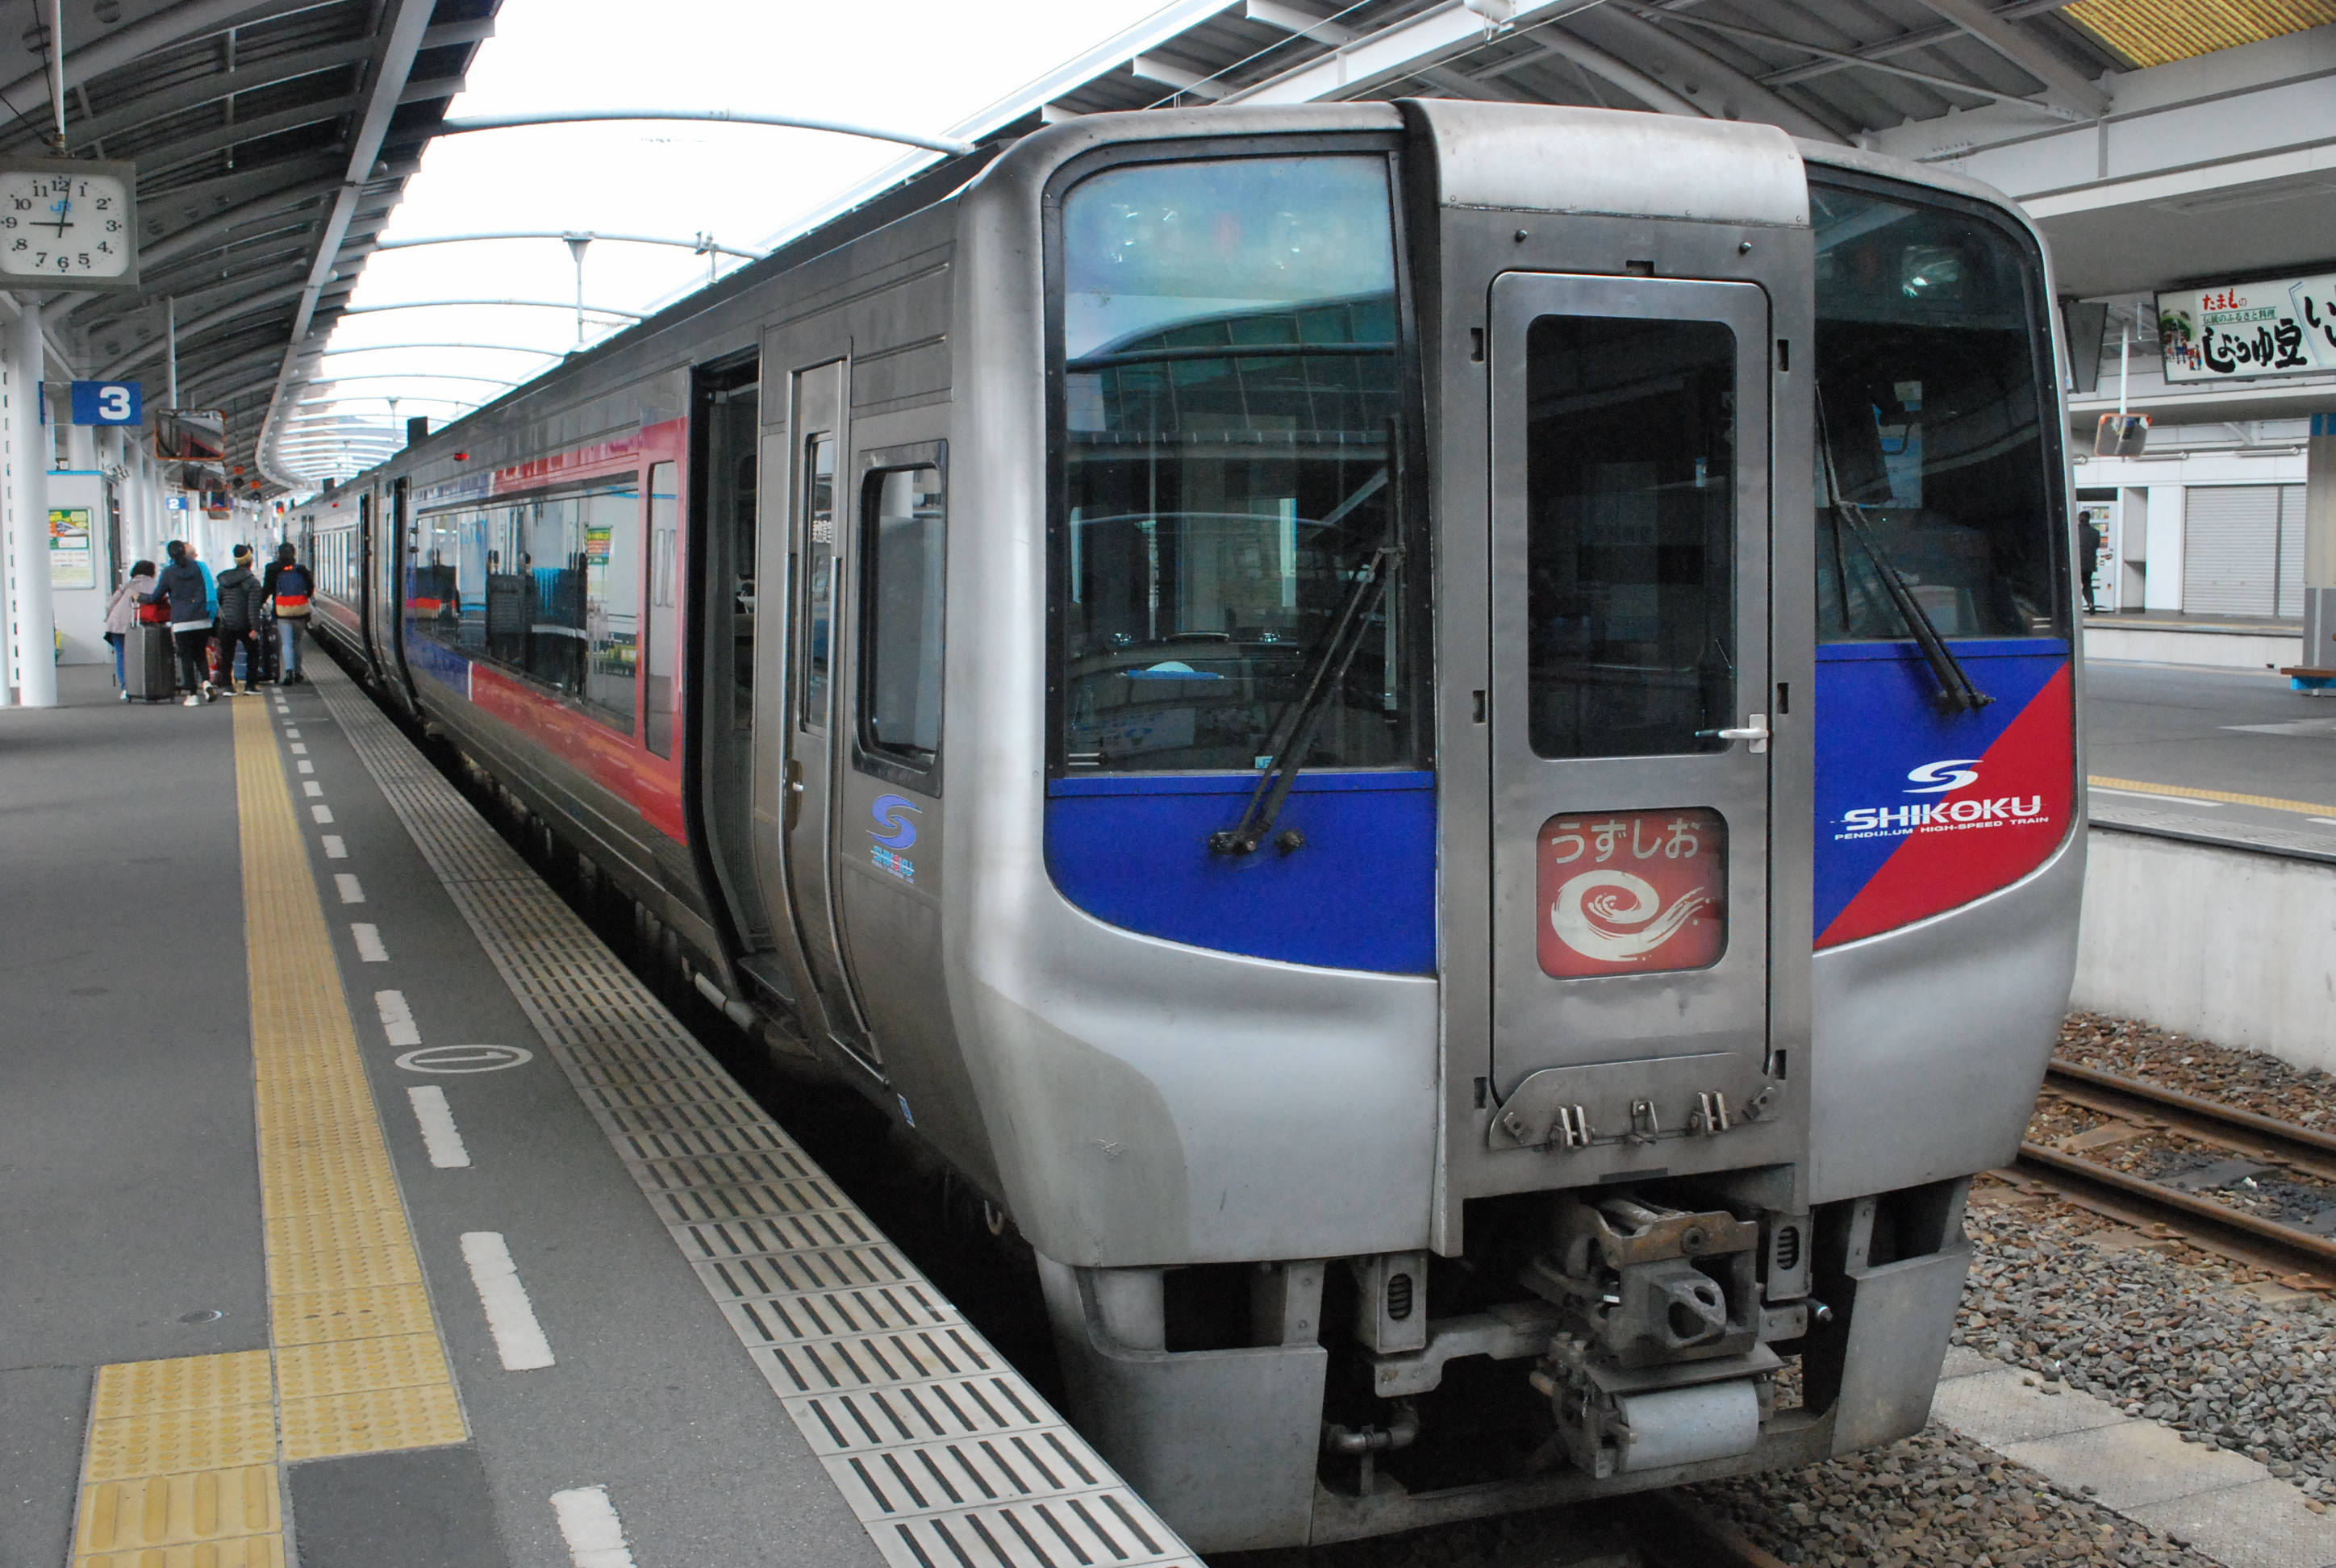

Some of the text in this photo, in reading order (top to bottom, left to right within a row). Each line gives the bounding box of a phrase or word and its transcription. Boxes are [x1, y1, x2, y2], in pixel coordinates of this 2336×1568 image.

[33, 186, 48, 197] 11
[52, 180, 69, 192] 12
[79, 185, 86, 197] 1
[15, 198, 32, 211] 10
[96, 198, 108, 210] 2
[5, 217, 18, 228] 9
[106, 220, 117, 231] 3
[15, 239, 27, 250] 8
[97, 241, 109, 252] 4
[36, 252, 48, 264] 7
[57, 256, 69, 269] 6
[78, 253, 90, 265] 5
[2202, 318, 2307, 373] しょうゆ豆
[99, 386, 131, 420] 3
[169, 498, 180, 510] 2
[1844, 795, 2042, 831] SHIKOKU
[1834, 816, 2049, 840] PENDULUM HIGH-SPEED TRAIN
[1551, 818, 1700, 865] うずしお
